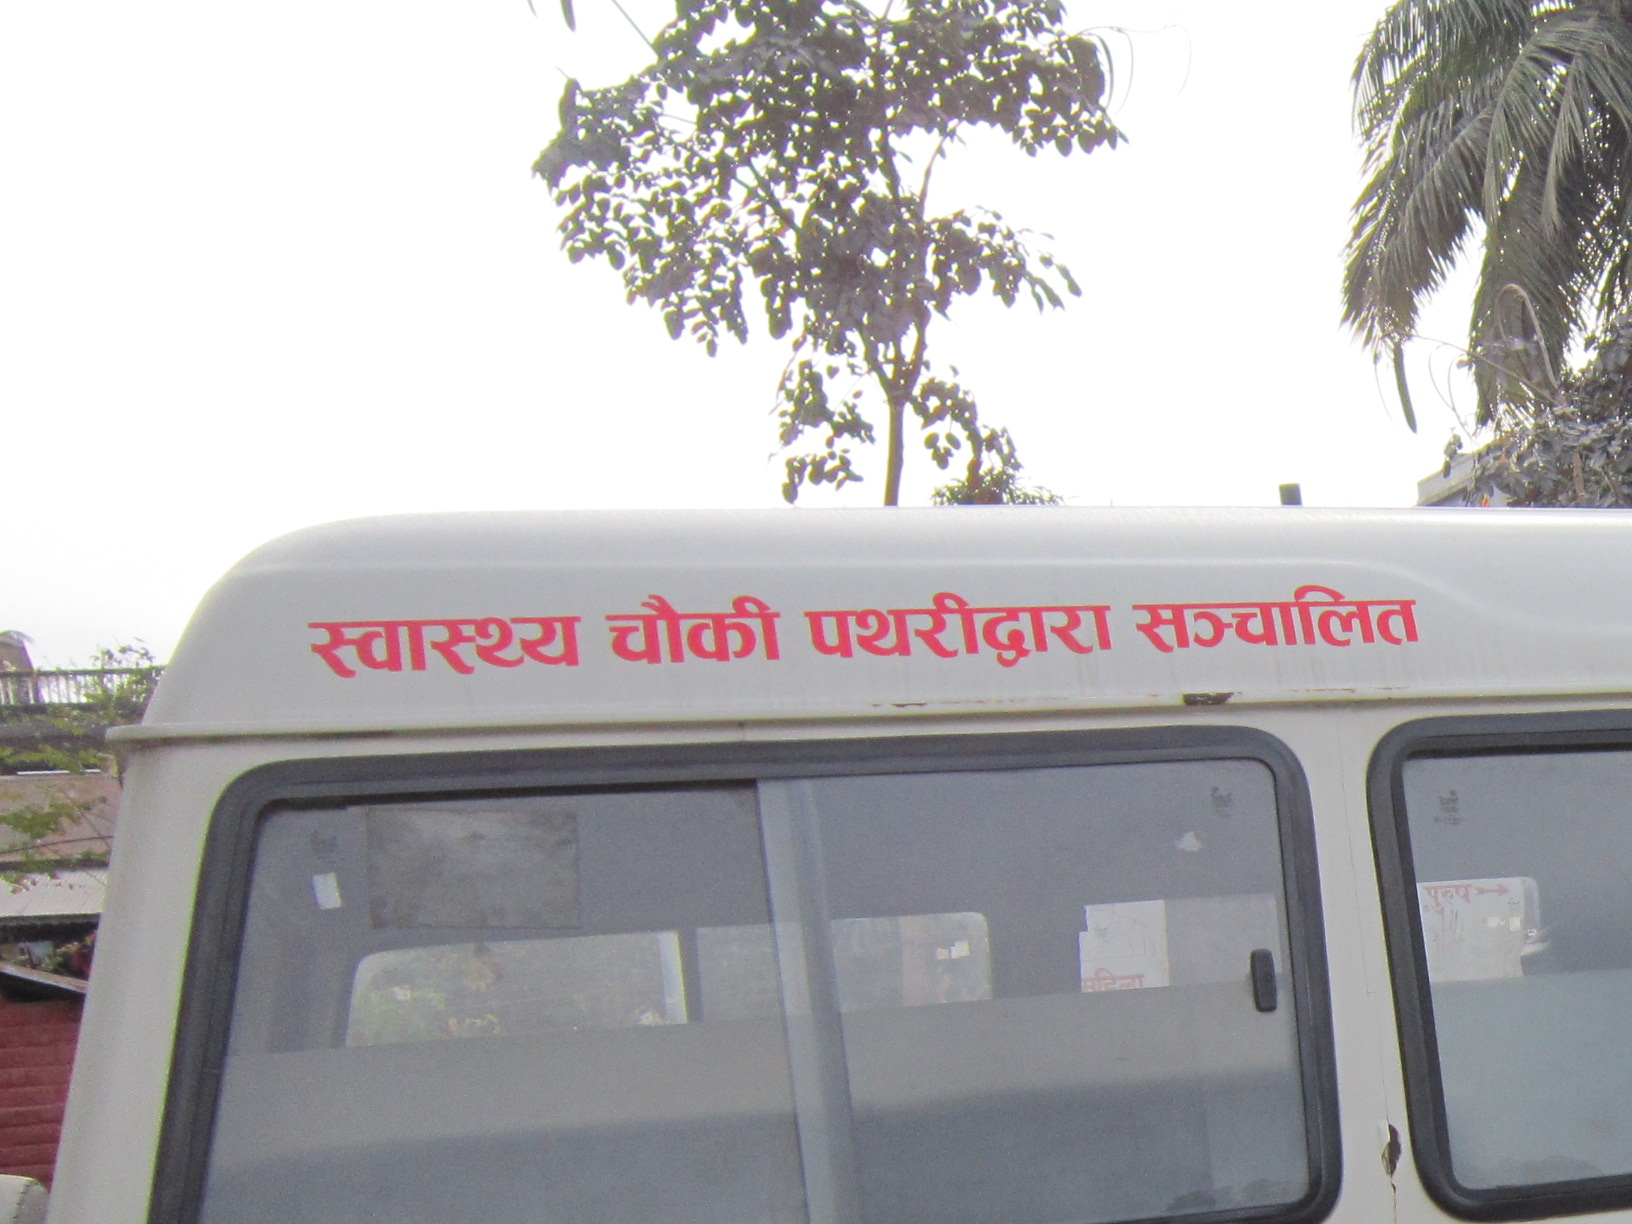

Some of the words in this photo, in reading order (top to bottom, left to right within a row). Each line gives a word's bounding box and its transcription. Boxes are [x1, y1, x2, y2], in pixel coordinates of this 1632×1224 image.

[308, 615, 582, 679] स्वास्थ्य
[605, 594, 781, 665] चौकी
[803, 591, 1112, 668] पथरीद्वारा
[1132, 584, 1419, 654] सञ्चालित
